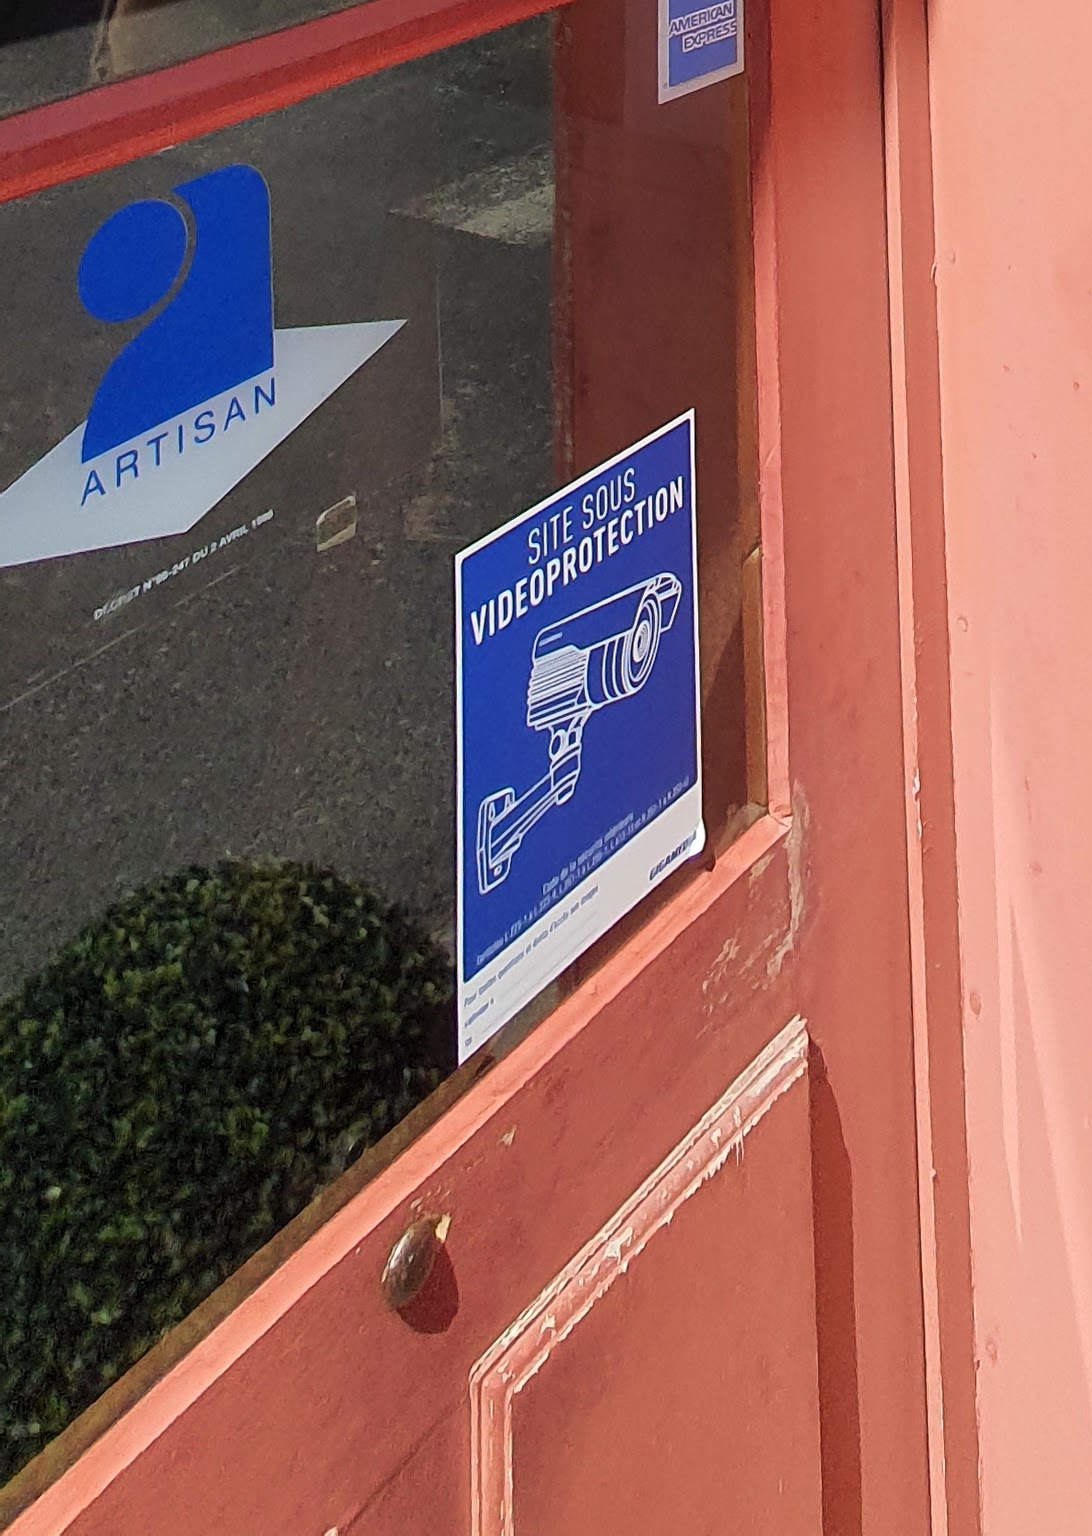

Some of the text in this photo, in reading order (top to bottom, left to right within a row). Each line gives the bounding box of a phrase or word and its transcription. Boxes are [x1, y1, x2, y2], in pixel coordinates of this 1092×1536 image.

[668, 2, 733, 35] AMERICAN
[684, 20, 737, 50] EXPRESS
[80, 378, 278, 506] ARTISAN
[470, 476, 684, 645] VIDEOPROTECTION
[526, 467, 636, 565] SITE SOUS
